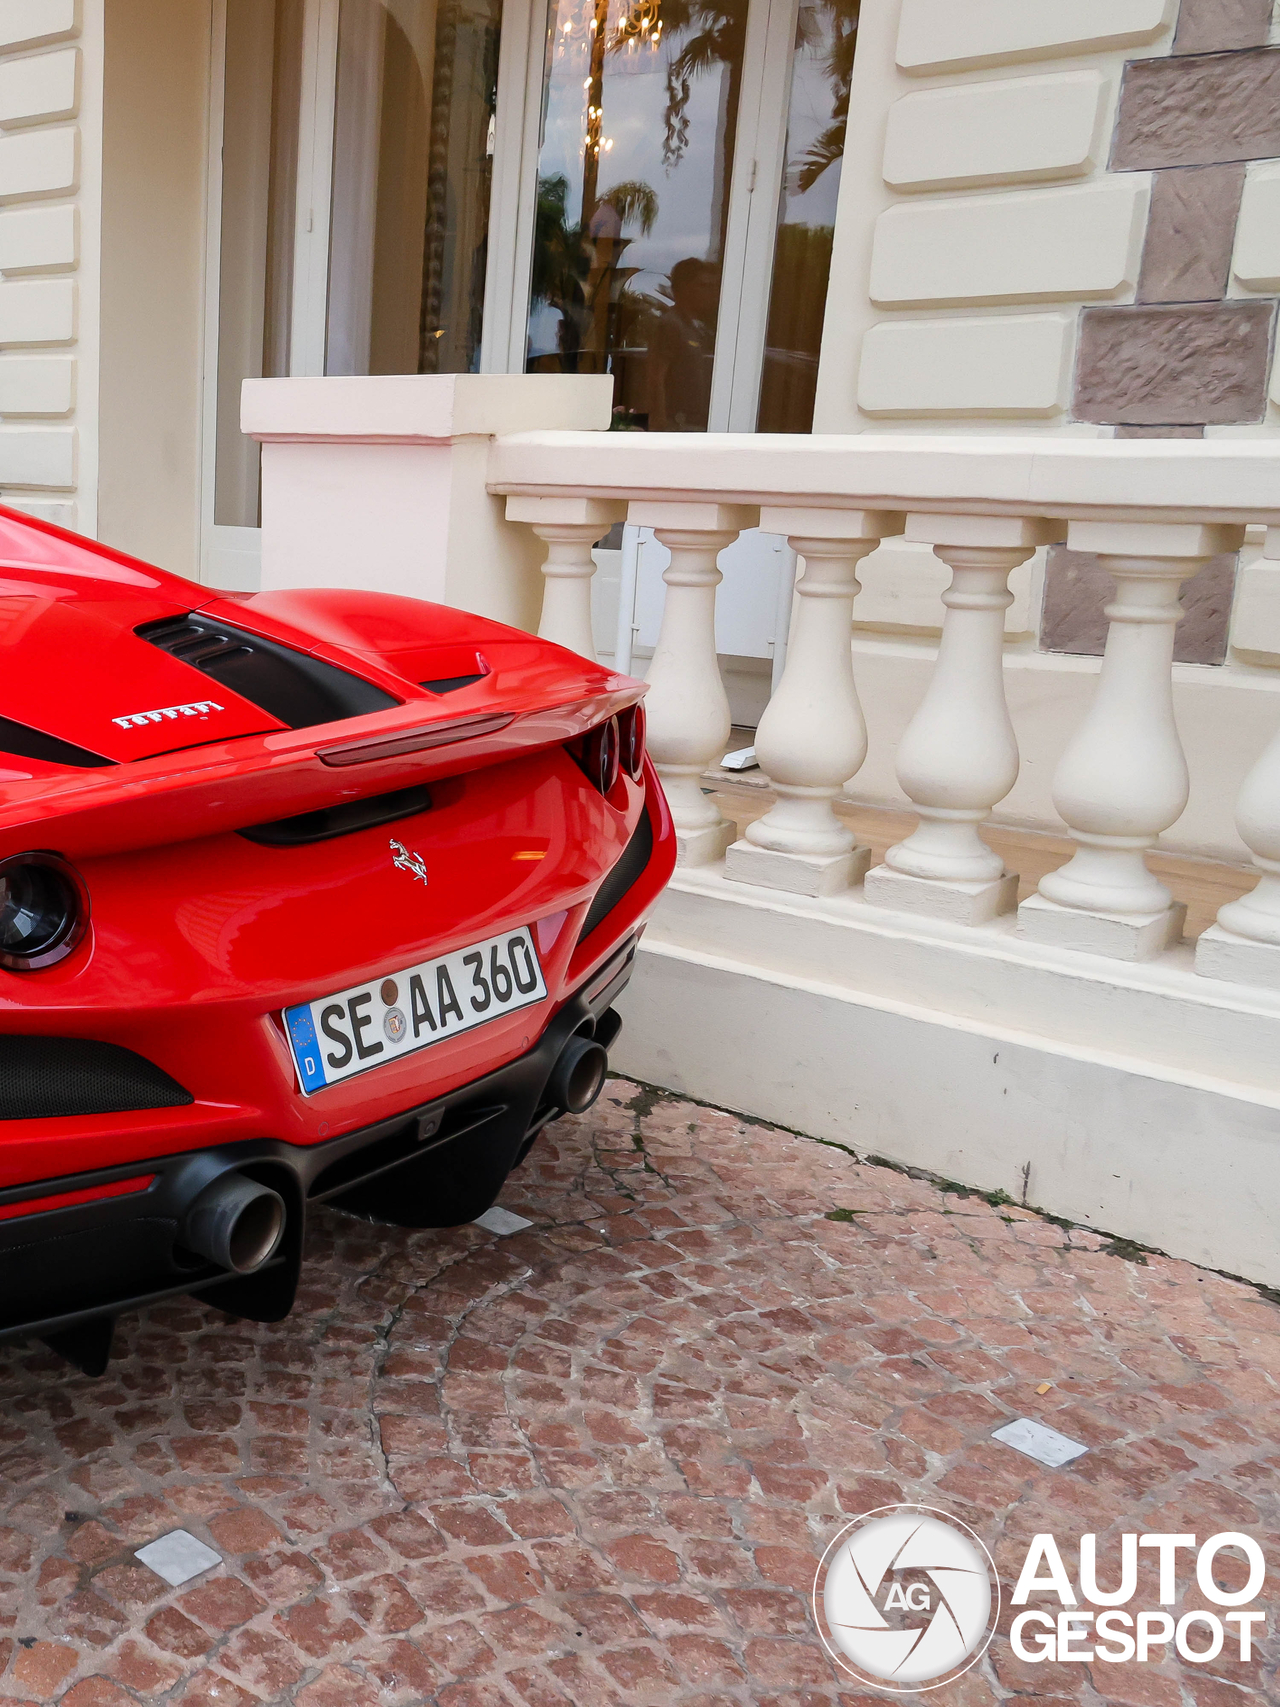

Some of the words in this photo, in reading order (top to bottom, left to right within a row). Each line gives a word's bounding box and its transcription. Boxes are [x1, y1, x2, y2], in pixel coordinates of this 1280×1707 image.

[111, 700, 225, 729] Ferrari
[320, 992, 384, 1069] SE
[409, 964, 464, 1038] AA
[463, 936, 537, 1013] 360
[304, 1056, 316, 1076] D
